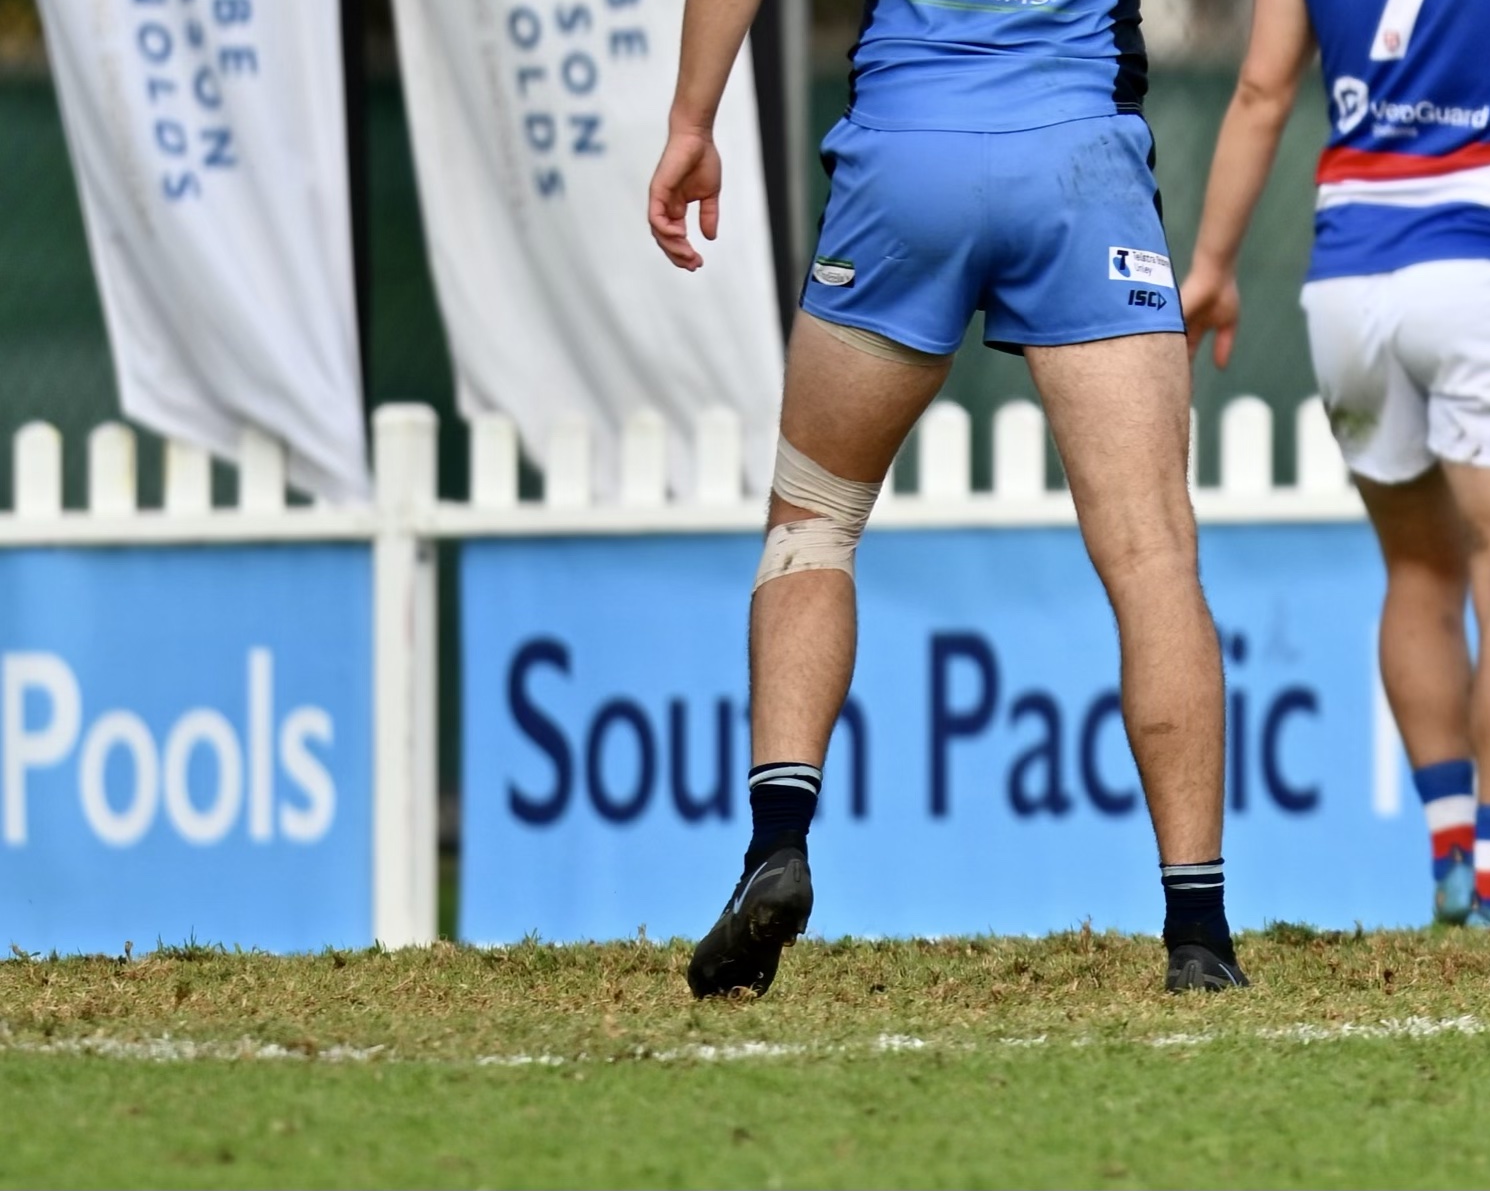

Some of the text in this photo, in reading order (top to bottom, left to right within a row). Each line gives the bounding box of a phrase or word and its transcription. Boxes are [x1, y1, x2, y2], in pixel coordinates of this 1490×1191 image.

[1371, 100, 1490, 129] VeoGuard
[3, 646, 336, 846] Pools
[506, 634, 868, 825] Sou
[928, 629, 1321, 820] Pacic
